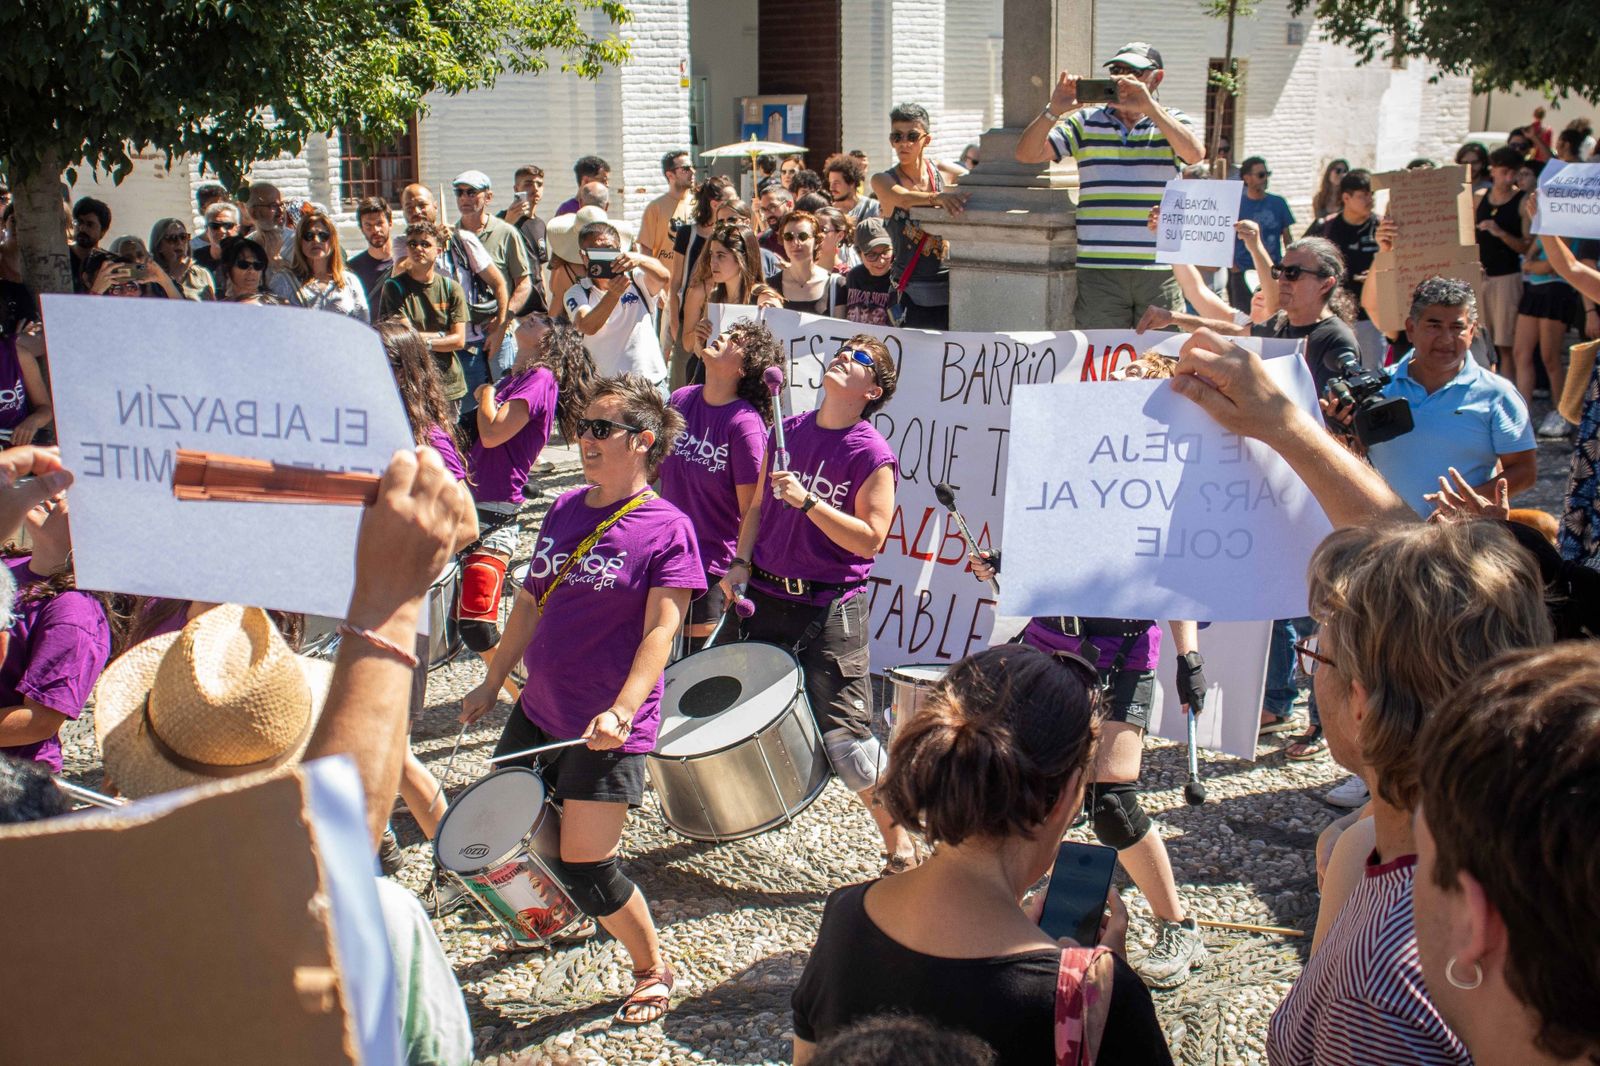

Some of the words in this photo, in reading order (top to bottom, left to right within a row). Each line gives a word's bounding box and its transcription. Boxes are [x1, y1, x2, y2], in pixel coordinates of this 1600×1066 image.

[1547, 187, 1595, 200] PELIGRO
[1162, 213, 1216, 227] PATRIMONIO
[1217, 215, 1231, 228] DE
[1165, 229, 1178, 240] SU
[1179, 230, 1226, 243] VECINDAD
